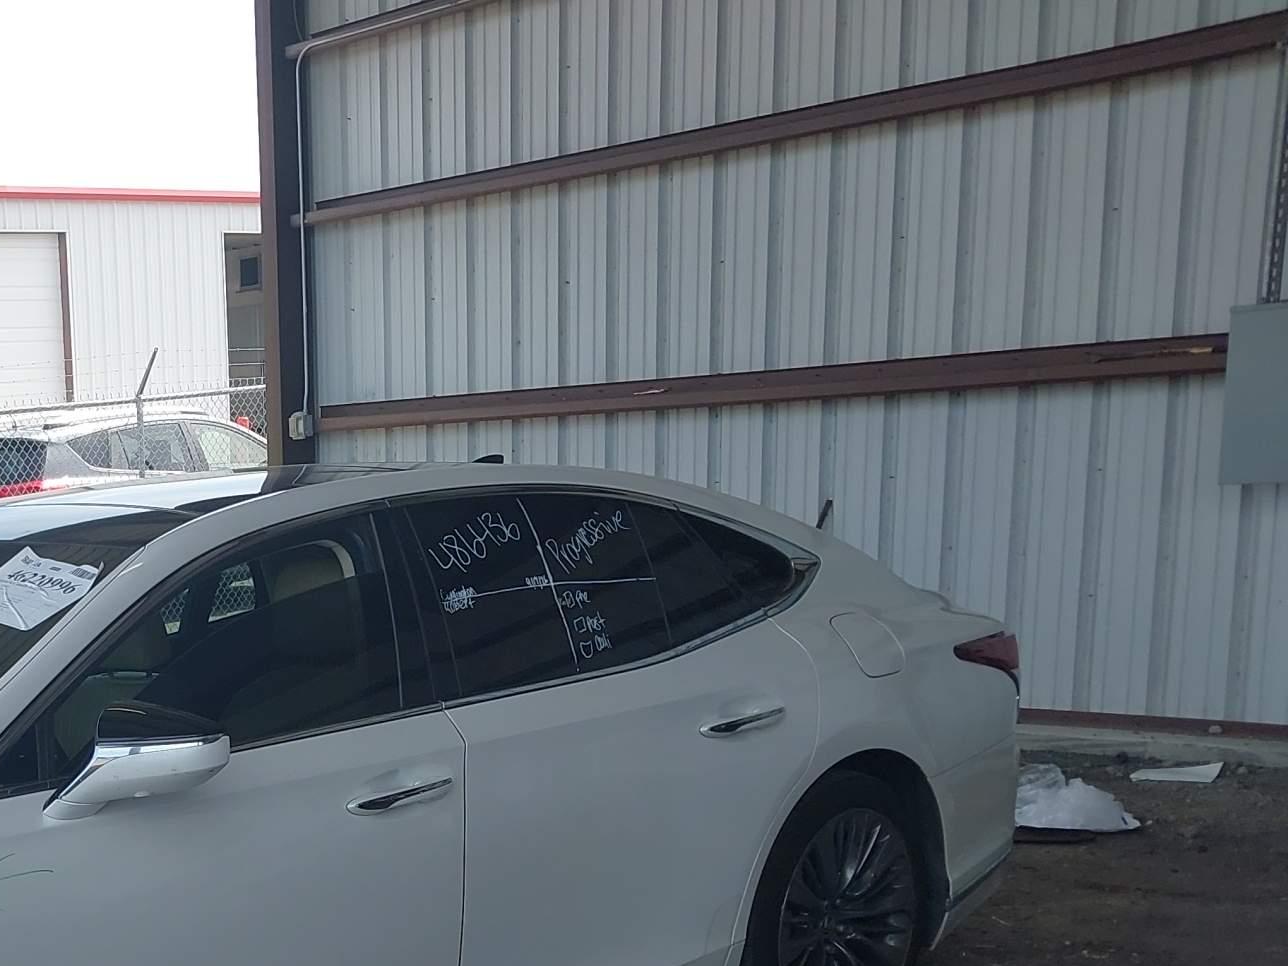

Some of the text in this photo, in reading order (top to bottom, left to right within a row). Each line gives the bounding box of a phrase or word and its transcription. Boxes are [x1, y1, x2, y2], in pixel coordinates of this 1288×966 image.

[428, 511, 521, 574] 486436
[545, 510, 631, 575] Progressive
[7, 569, 81, 595] 46220996
